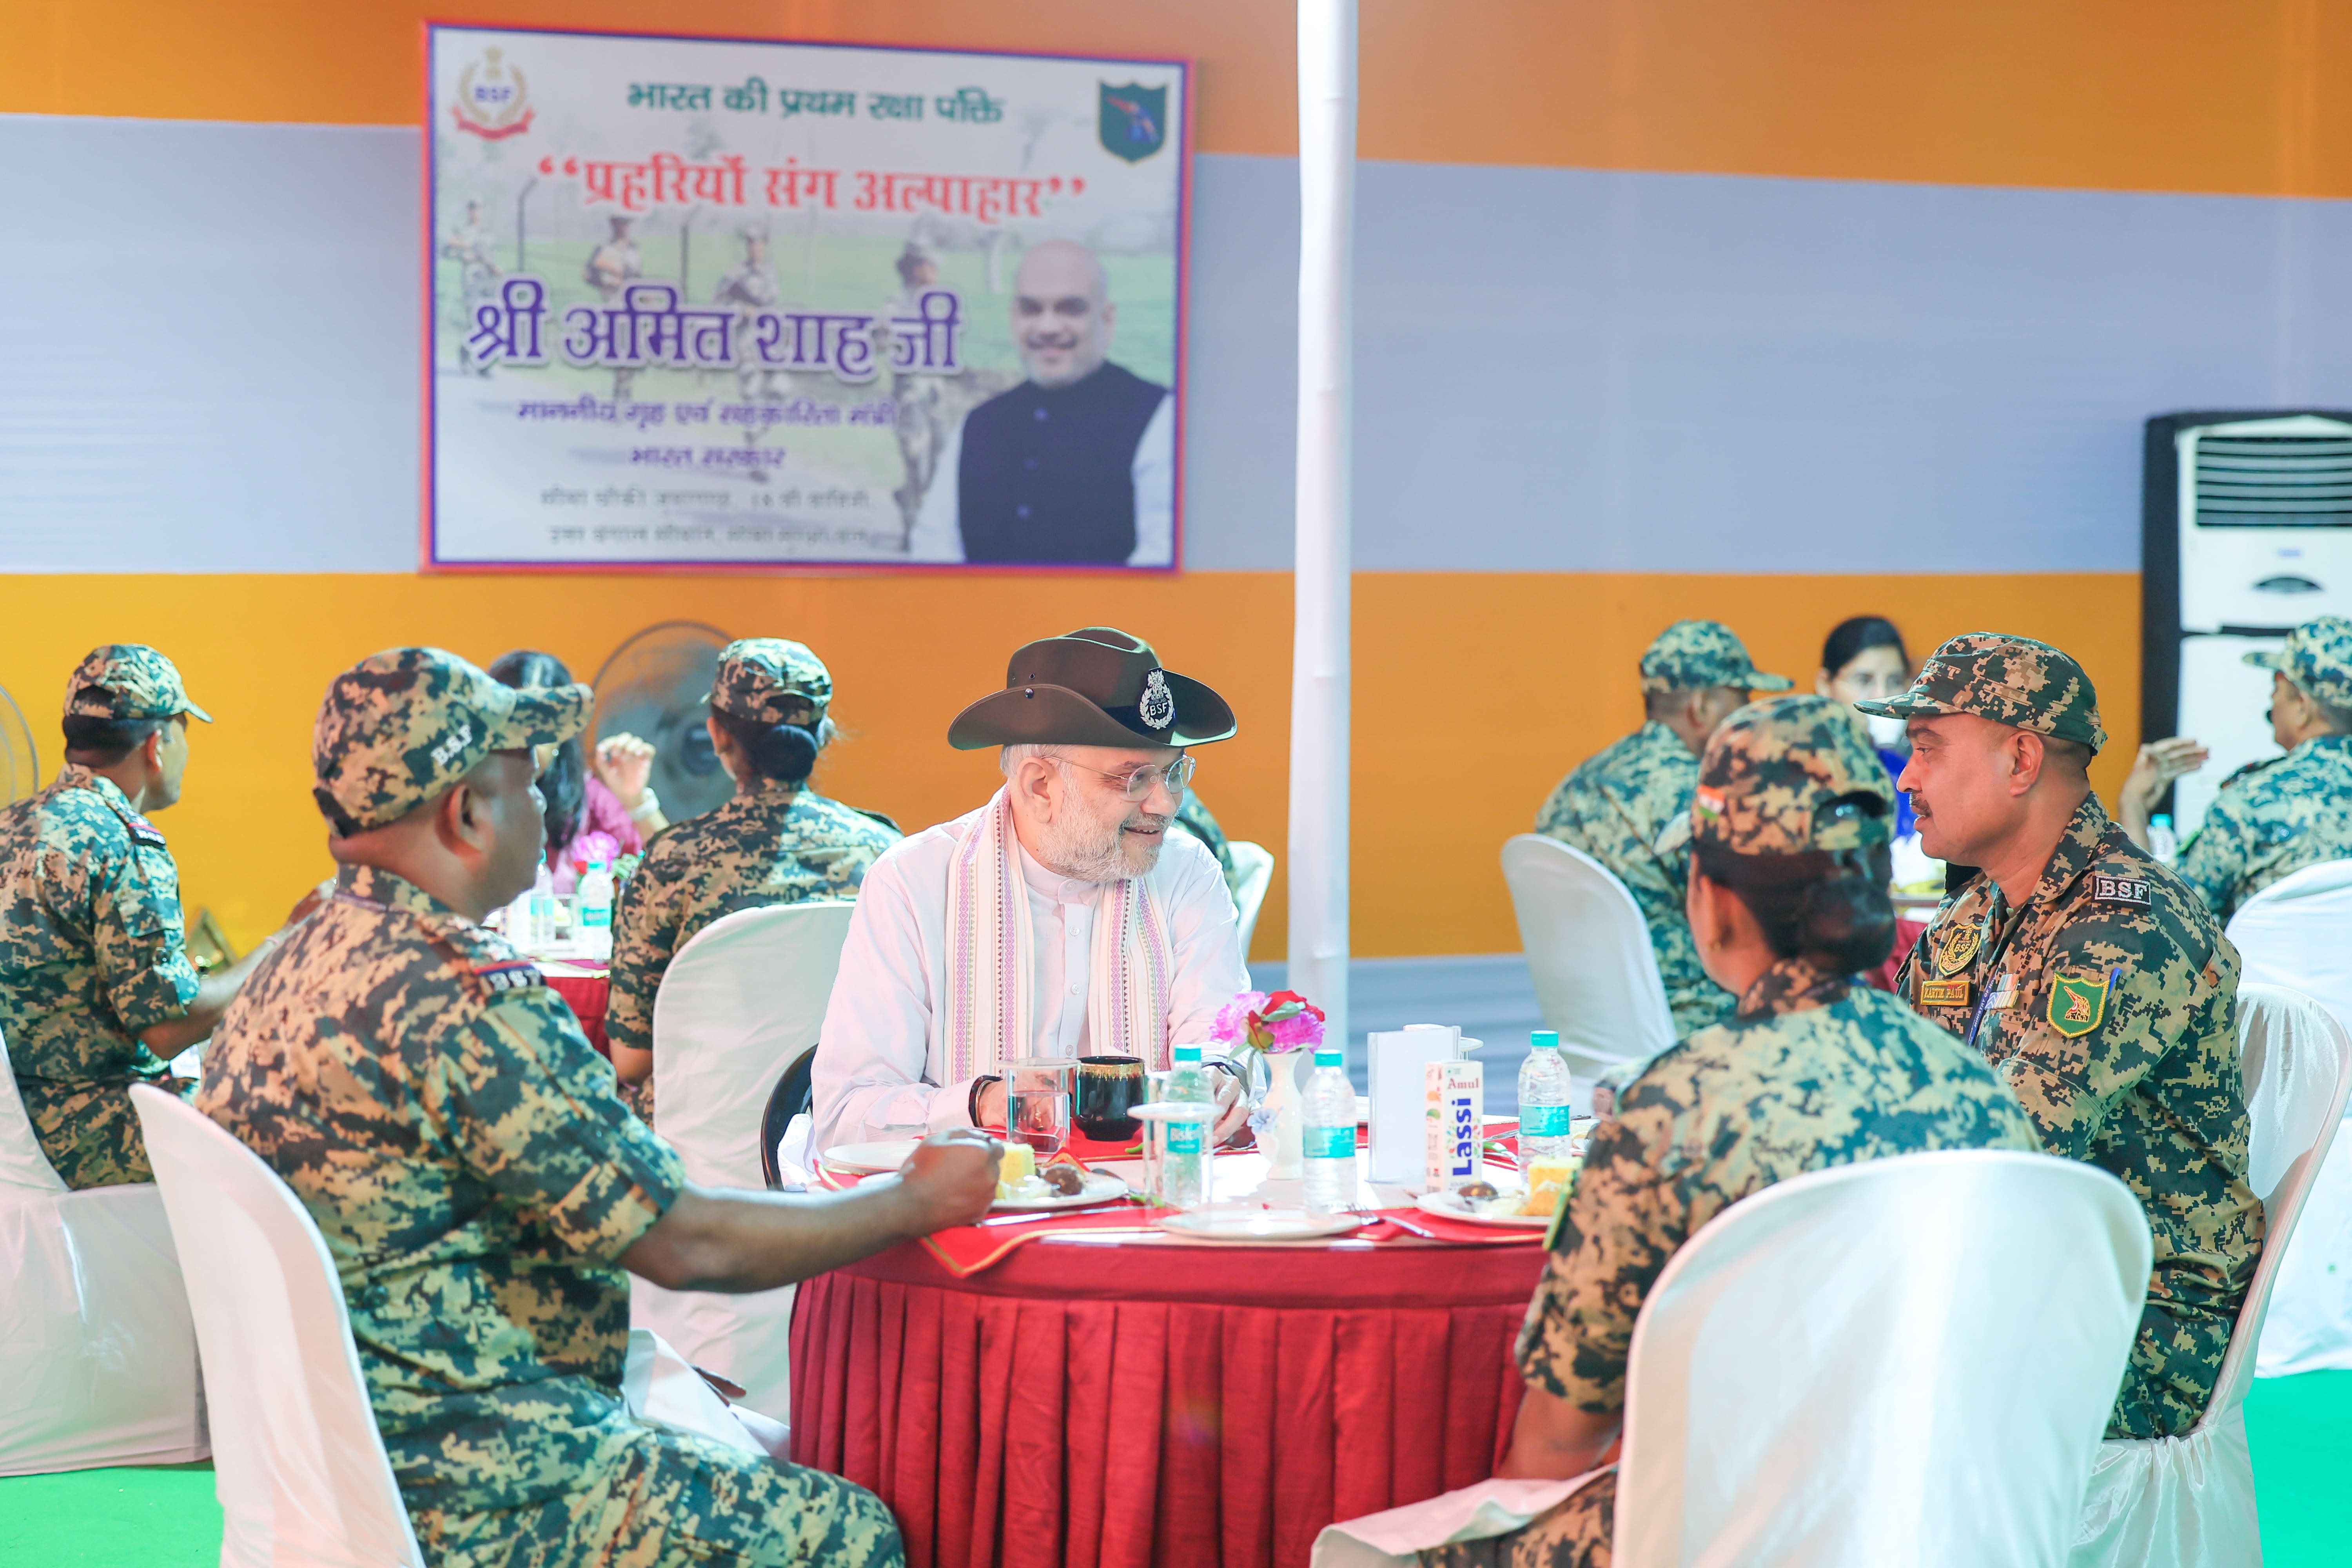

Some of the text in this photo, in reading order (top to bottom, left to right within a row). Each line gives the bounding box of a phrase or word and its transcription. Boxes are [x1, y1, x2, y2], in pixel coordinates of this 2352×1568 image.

[627, 82, 711, 112] भारत
[723, 76, 767, 113] की
[779, 89, 856, 119] प्रथम
[867, 92, 923, 120] रक्षा
[764, 158, 838, 208] संग
[470, 279, 960, 376] श्री अमित शाह जी
[1149, 702, 1168, 716] BSF
[2100, 880, 2147, 900] BSF
[1954, 944, 1970, 952] BSF
[1946, 988, 1964, 998] PAUL
[1974, 999, 1985, 1028] MINISTRY
[1984, 989, 1989, 998] OF
[1448, 1078, 1479, 1089] Amul
[1452, 1098, 1472, 1176] Lassi
